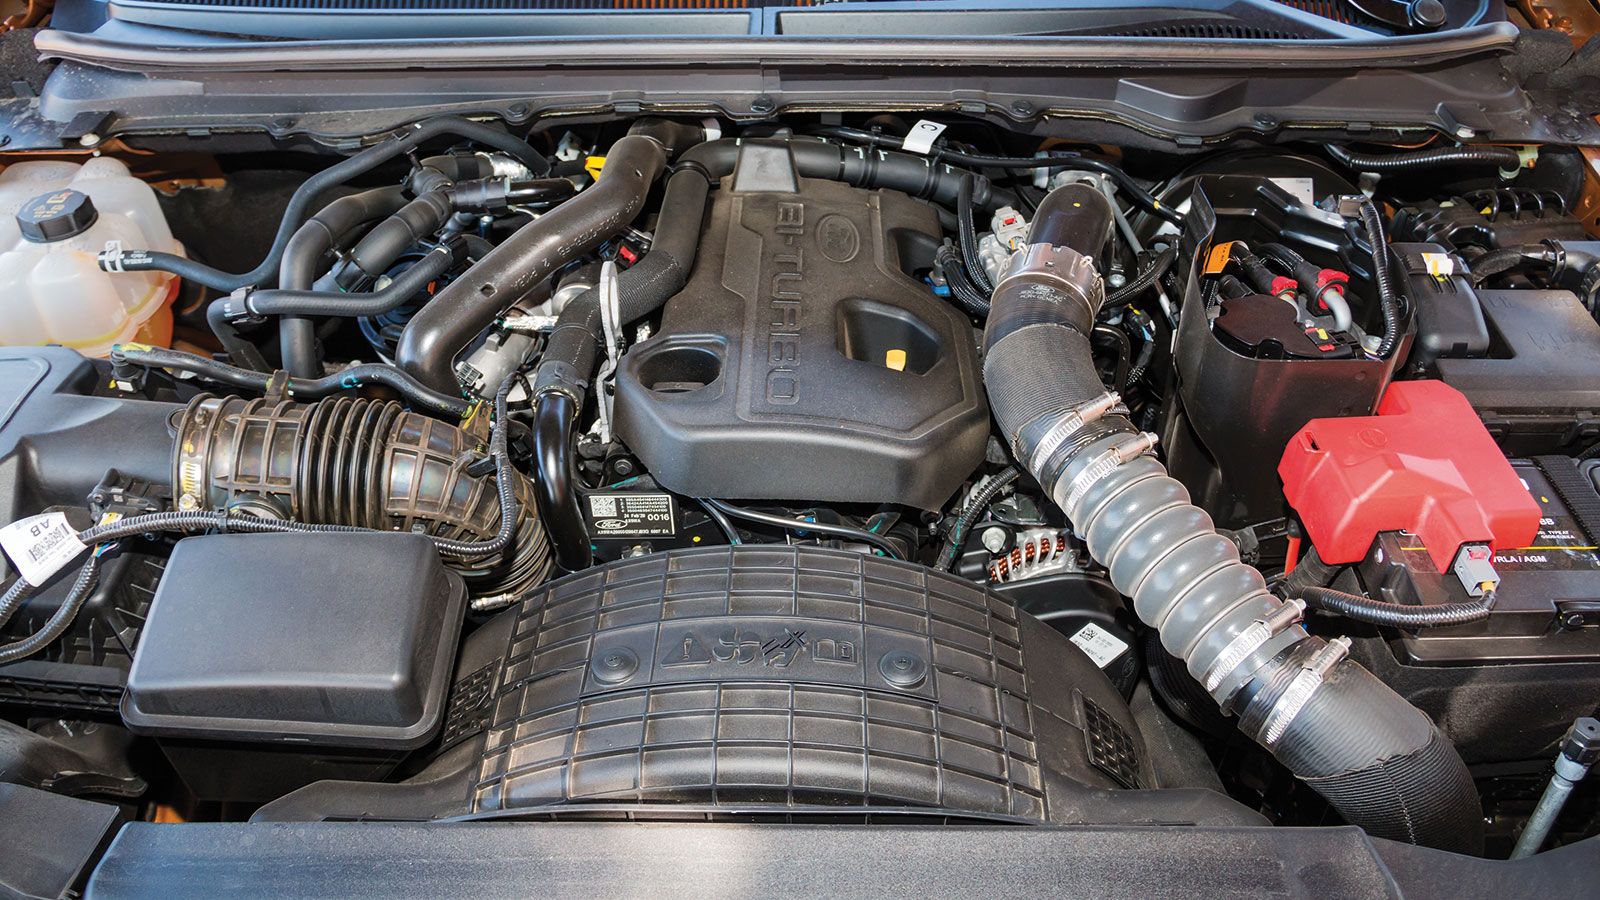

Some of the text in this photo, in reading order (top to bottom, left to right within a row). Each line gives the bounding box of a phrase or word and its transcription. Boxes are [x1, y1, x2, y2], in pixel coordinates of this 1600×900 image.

[766, 202, 804, 406] BI-TURBO
[647, 513, 670, 521] 0016
[1524, 555, 1548, 563] AGM
